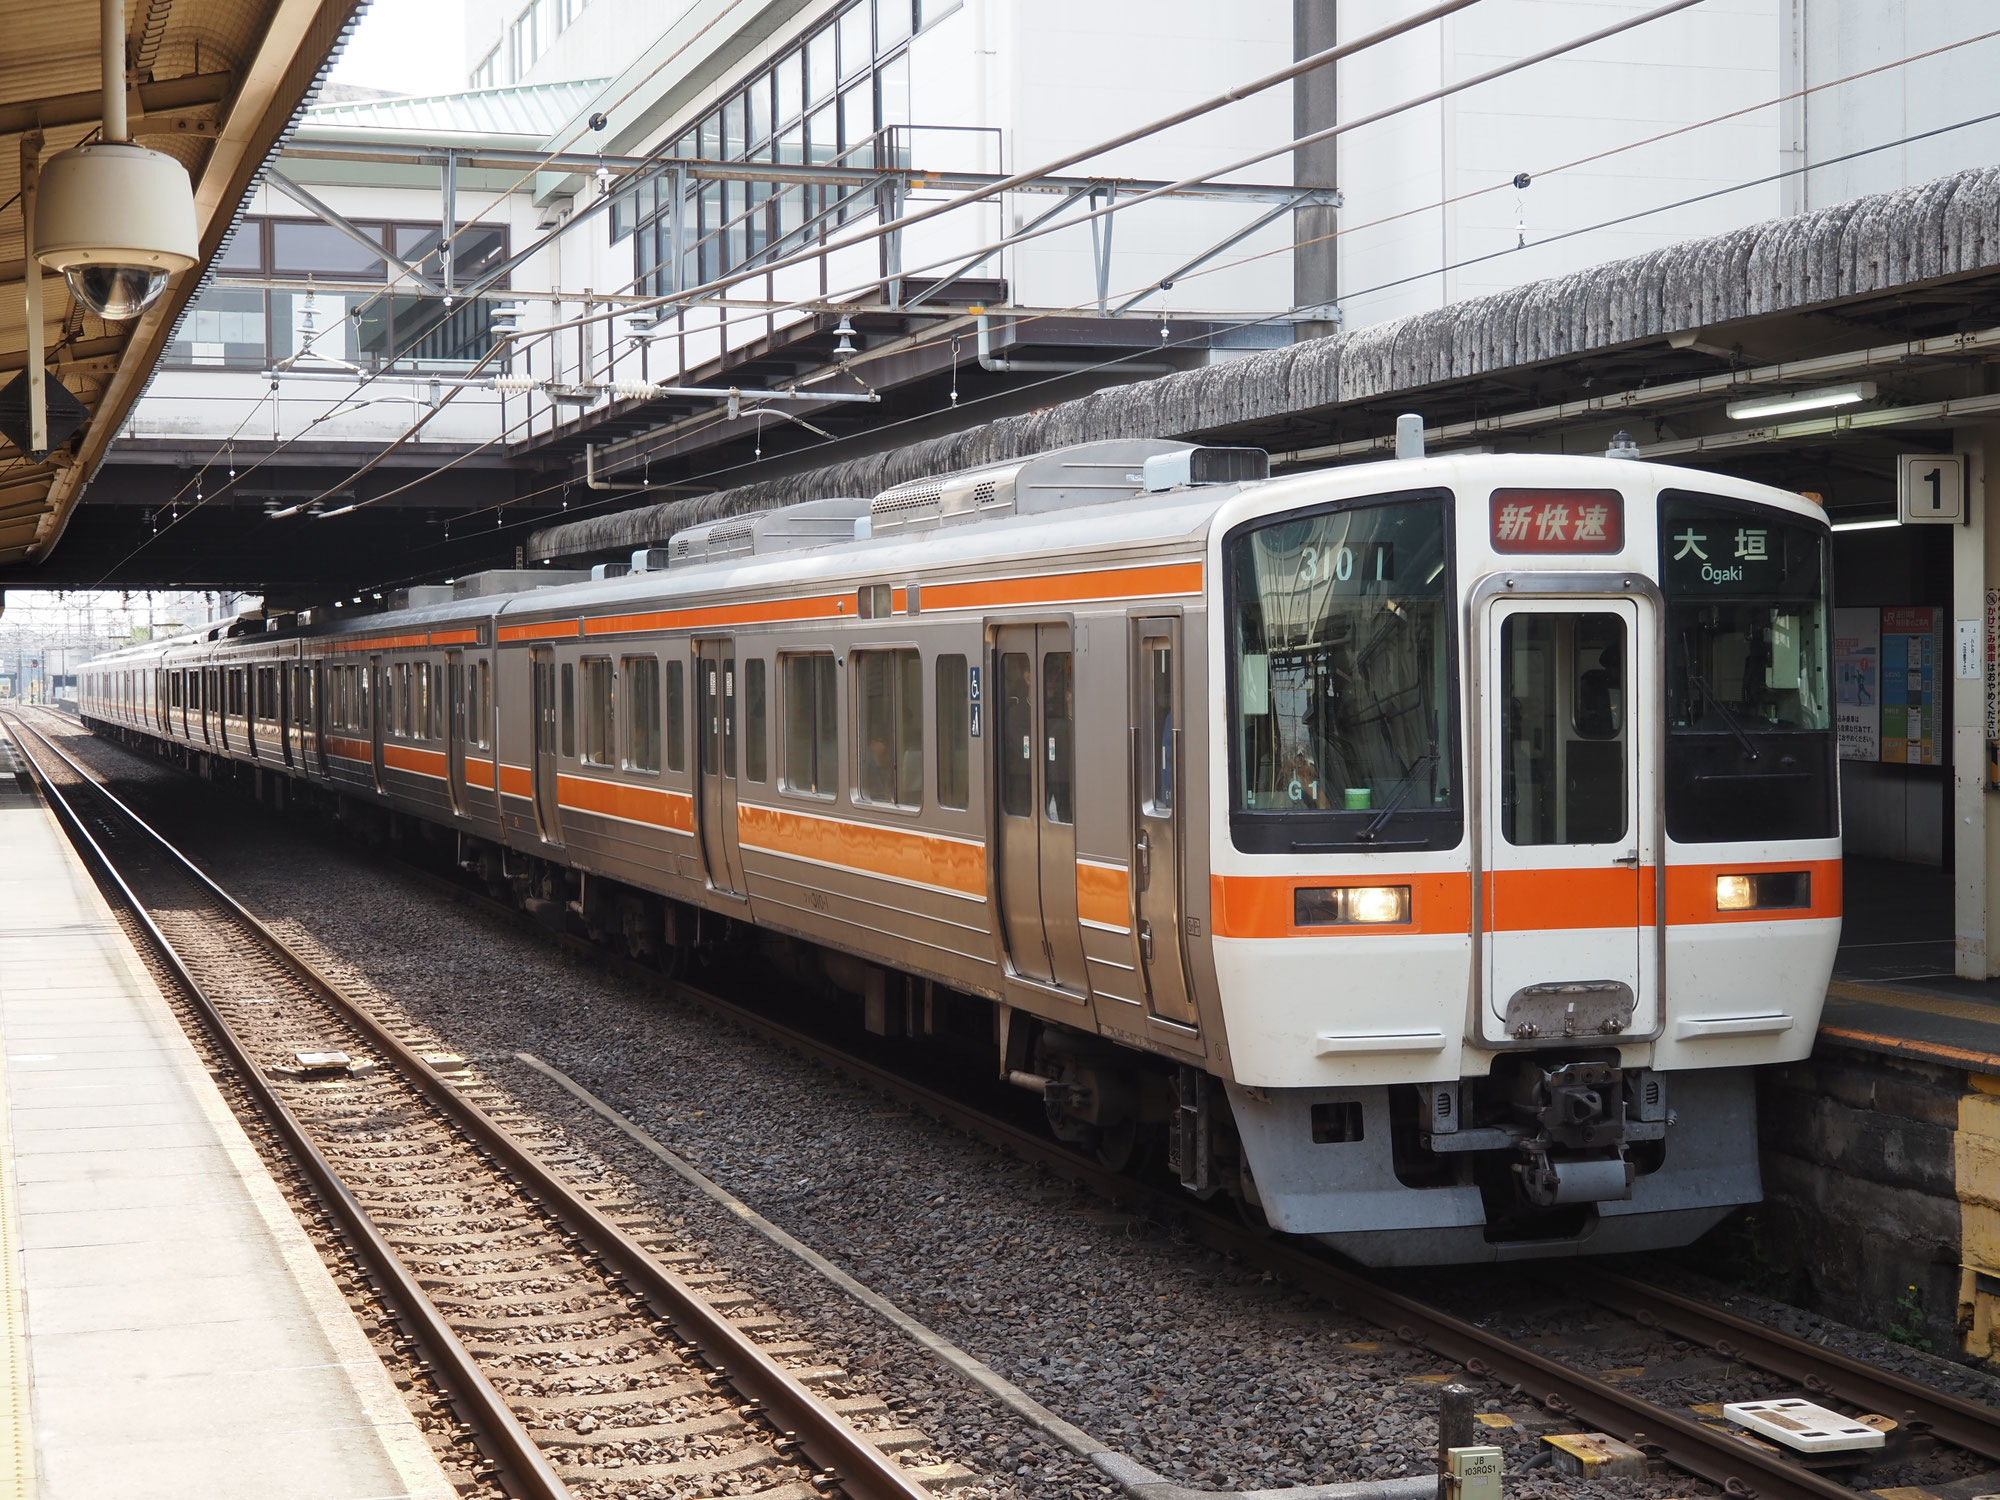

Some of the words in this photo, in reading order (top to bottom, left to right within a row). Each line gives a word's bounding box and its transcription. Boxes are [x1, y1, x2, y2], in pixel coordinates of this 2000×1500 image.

[1923, 468, 1941, 509] 1
[1496, 504, 1608, 540] 新快速
[1673, 527, 1768, 560] 大垣
[1301, 547, 1353, 580] 310
[1701, 563, 1743, 584] Ōgaki
[1883, 612, 1896, 623] JR
[1986, 607, 1997, 738] かけこみ乗車はおやめください
[1465, 1464, 1496, 1476] 103RQS1
[1475, 1457, 1485, 1466] JB
